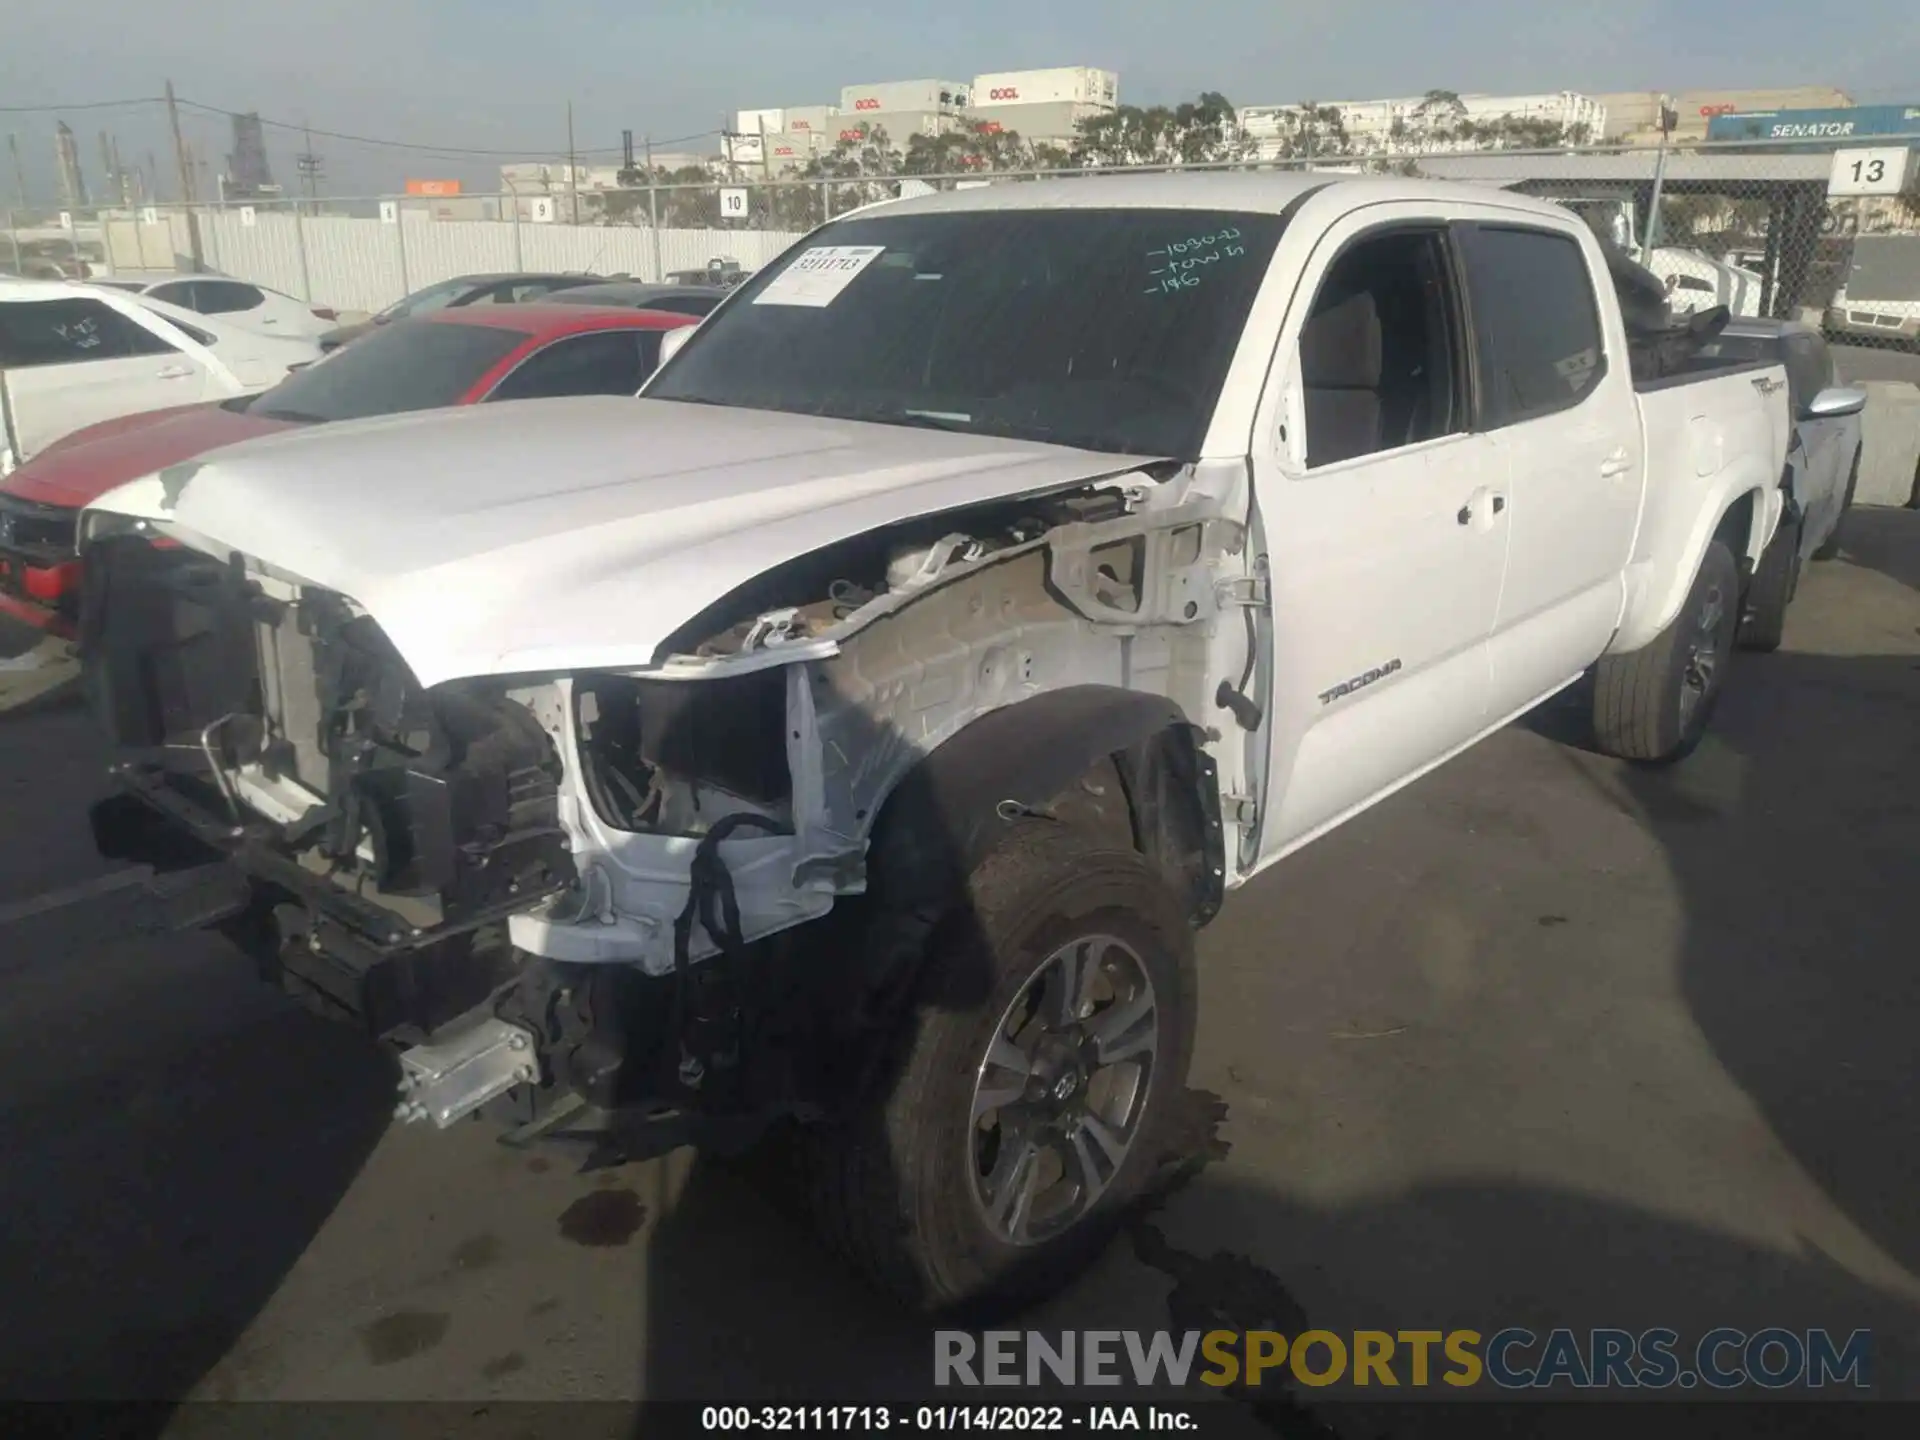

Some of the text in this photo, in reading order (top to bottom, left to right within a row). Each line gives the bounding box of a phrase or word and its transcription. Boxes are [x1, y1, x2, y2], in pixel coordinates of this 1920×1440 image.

[1770, 122, 1855, 138] SENATOR
[1851, 159, 1885, 183] 13
[538, 203, 546, 216] 9
[727, 195, 741, 210] 10
[1317, 658, 1402, 704] TACOMA
